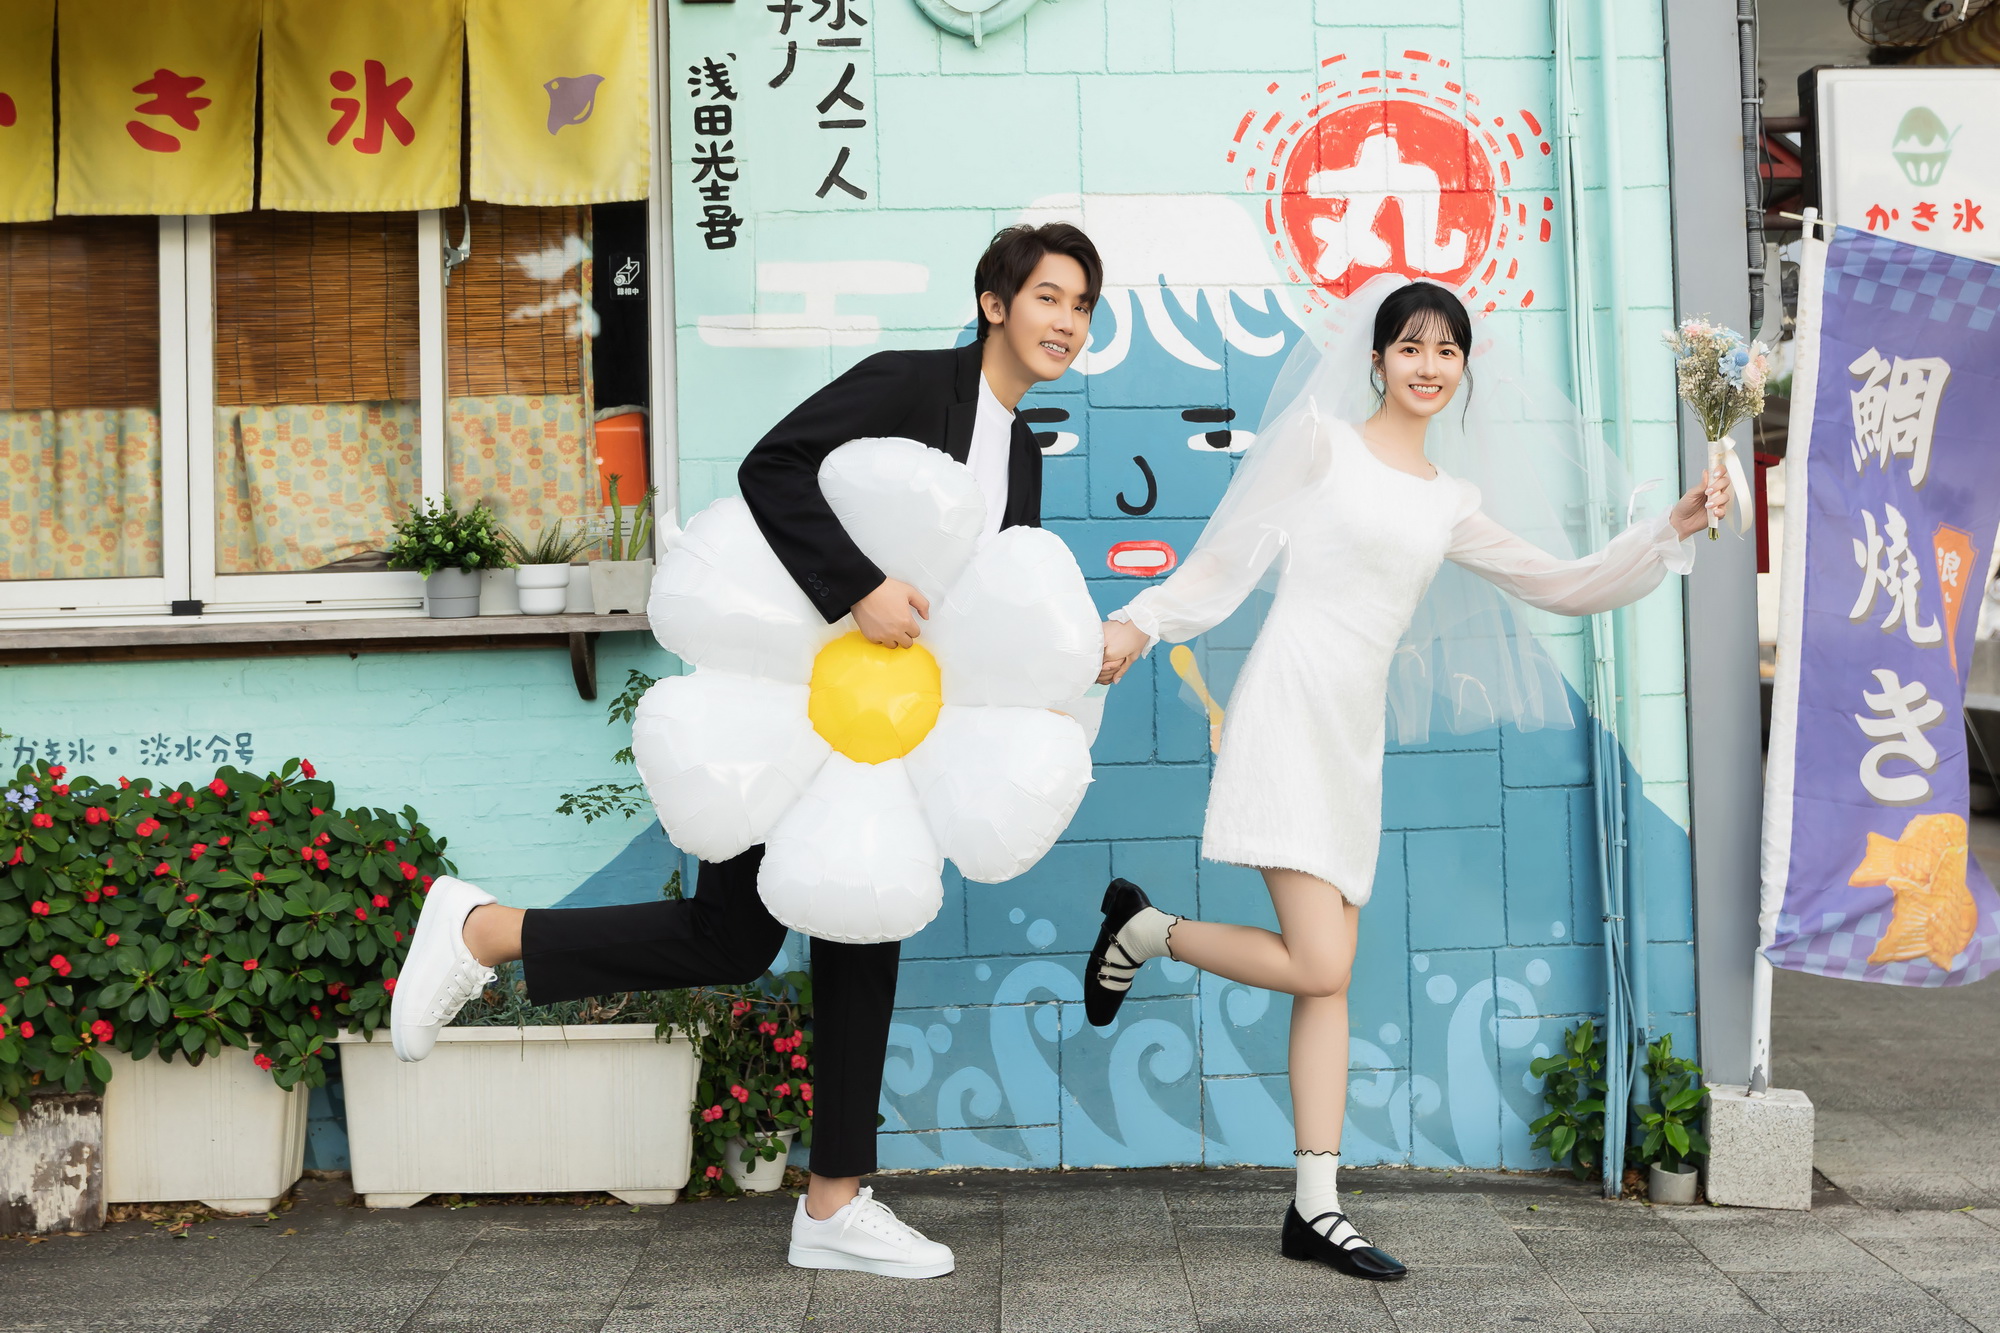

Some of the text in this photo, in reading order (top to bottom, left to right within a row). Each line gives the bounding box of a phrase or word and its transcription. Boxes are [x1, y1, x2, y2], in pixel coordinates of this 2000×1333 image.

[687, 53, 743, 250] 浅田光喜
[1307, 124, 1469, 280] 丸
[1866, 199, 1984, 232] かき氷
